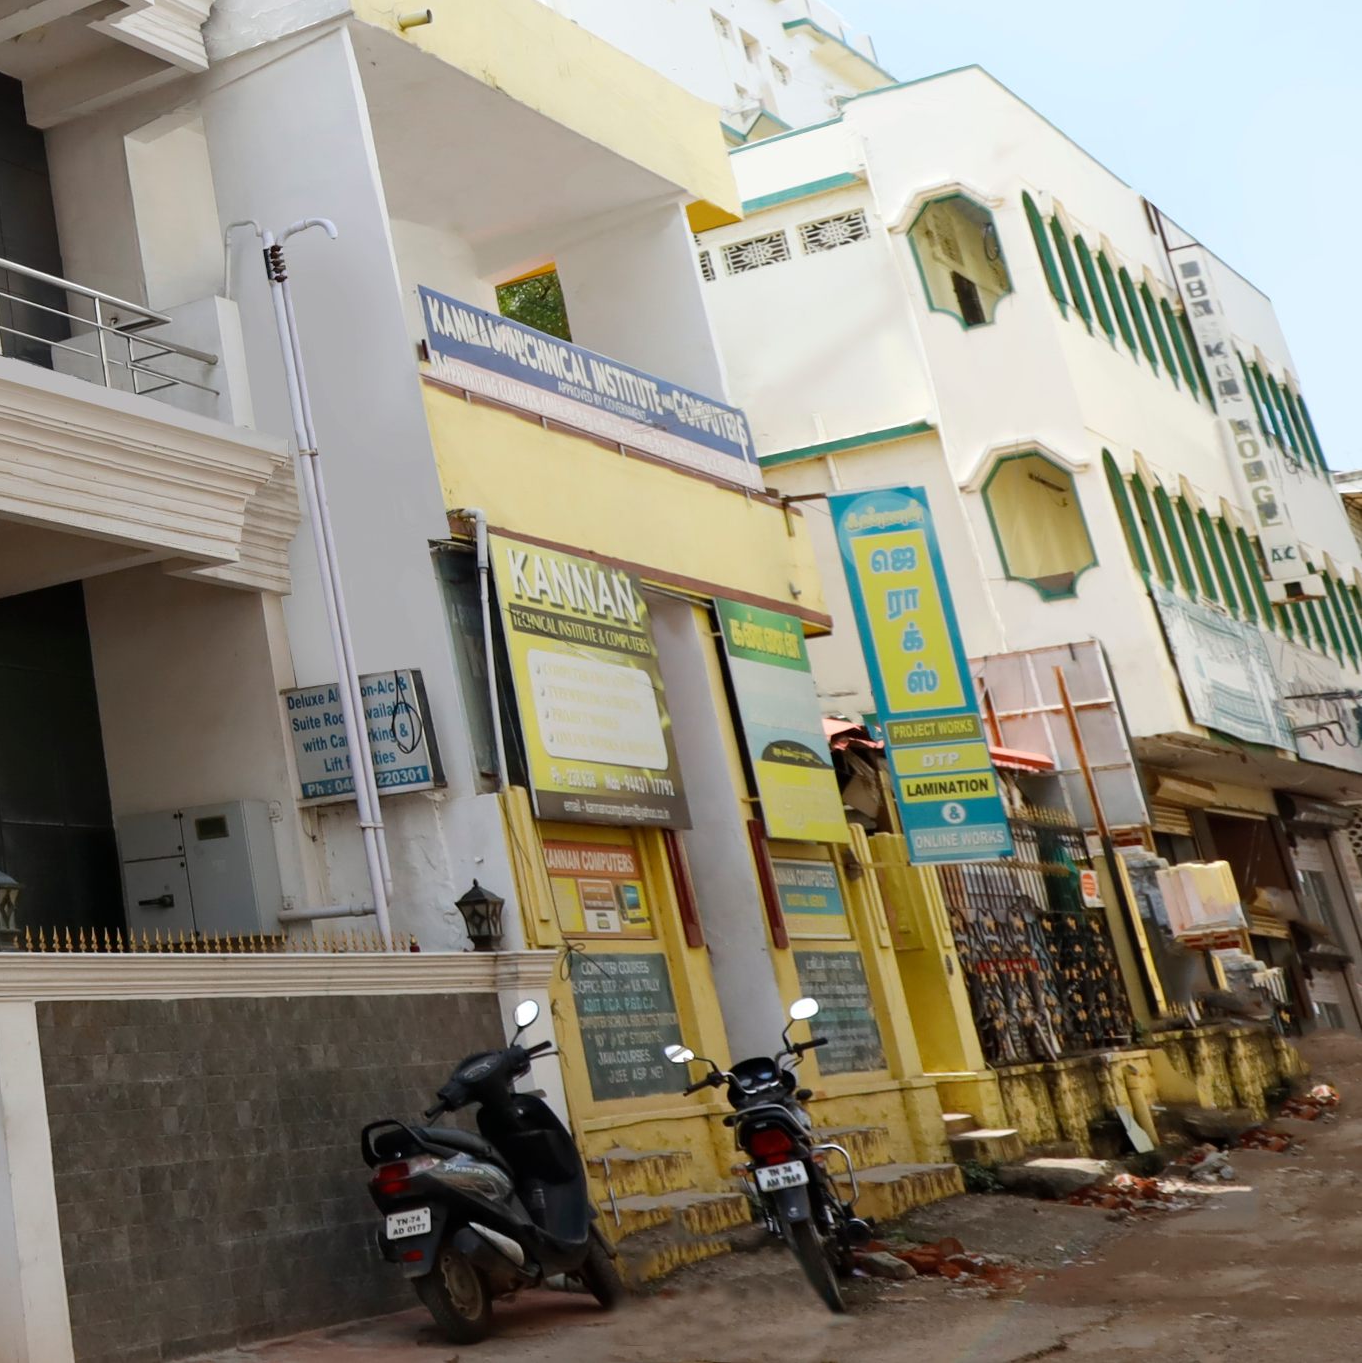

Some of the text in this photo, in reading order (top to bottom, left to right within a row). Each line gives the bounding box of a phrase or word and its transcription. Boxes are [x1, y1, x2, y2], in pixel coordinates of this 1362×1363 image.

[589, 358, 664, 416] INSTITUTE
[506, 547, 641, 626] KANNAN
[511, 608, 558, 635] TECHNICAL
[558, 620, 598, 643] INSTITUTE
[605, 629, 651, 654] COMPUTERS
[287, 693, 325, 711] Deluxe
[359, 679, 395, 698] on-A/c
[292, 715, 321, 732] Suite
[892, 718, 975, 739] PROJECT WORKS
[303, 736, 328, 753] with
[399, 722, 409, 738] &
[323, 756, 344, 773] Lift
[922, 751, 960, 768] DTP
[906, 778, 989, 797] LAMINATION
[948, 805, 961, 820] &
[915, 830, 1005, 849] ONLINE WORKS
[581, 850, 635, 873] COMPUTERS
[393, 1223, 426, 1236] AD 0177
